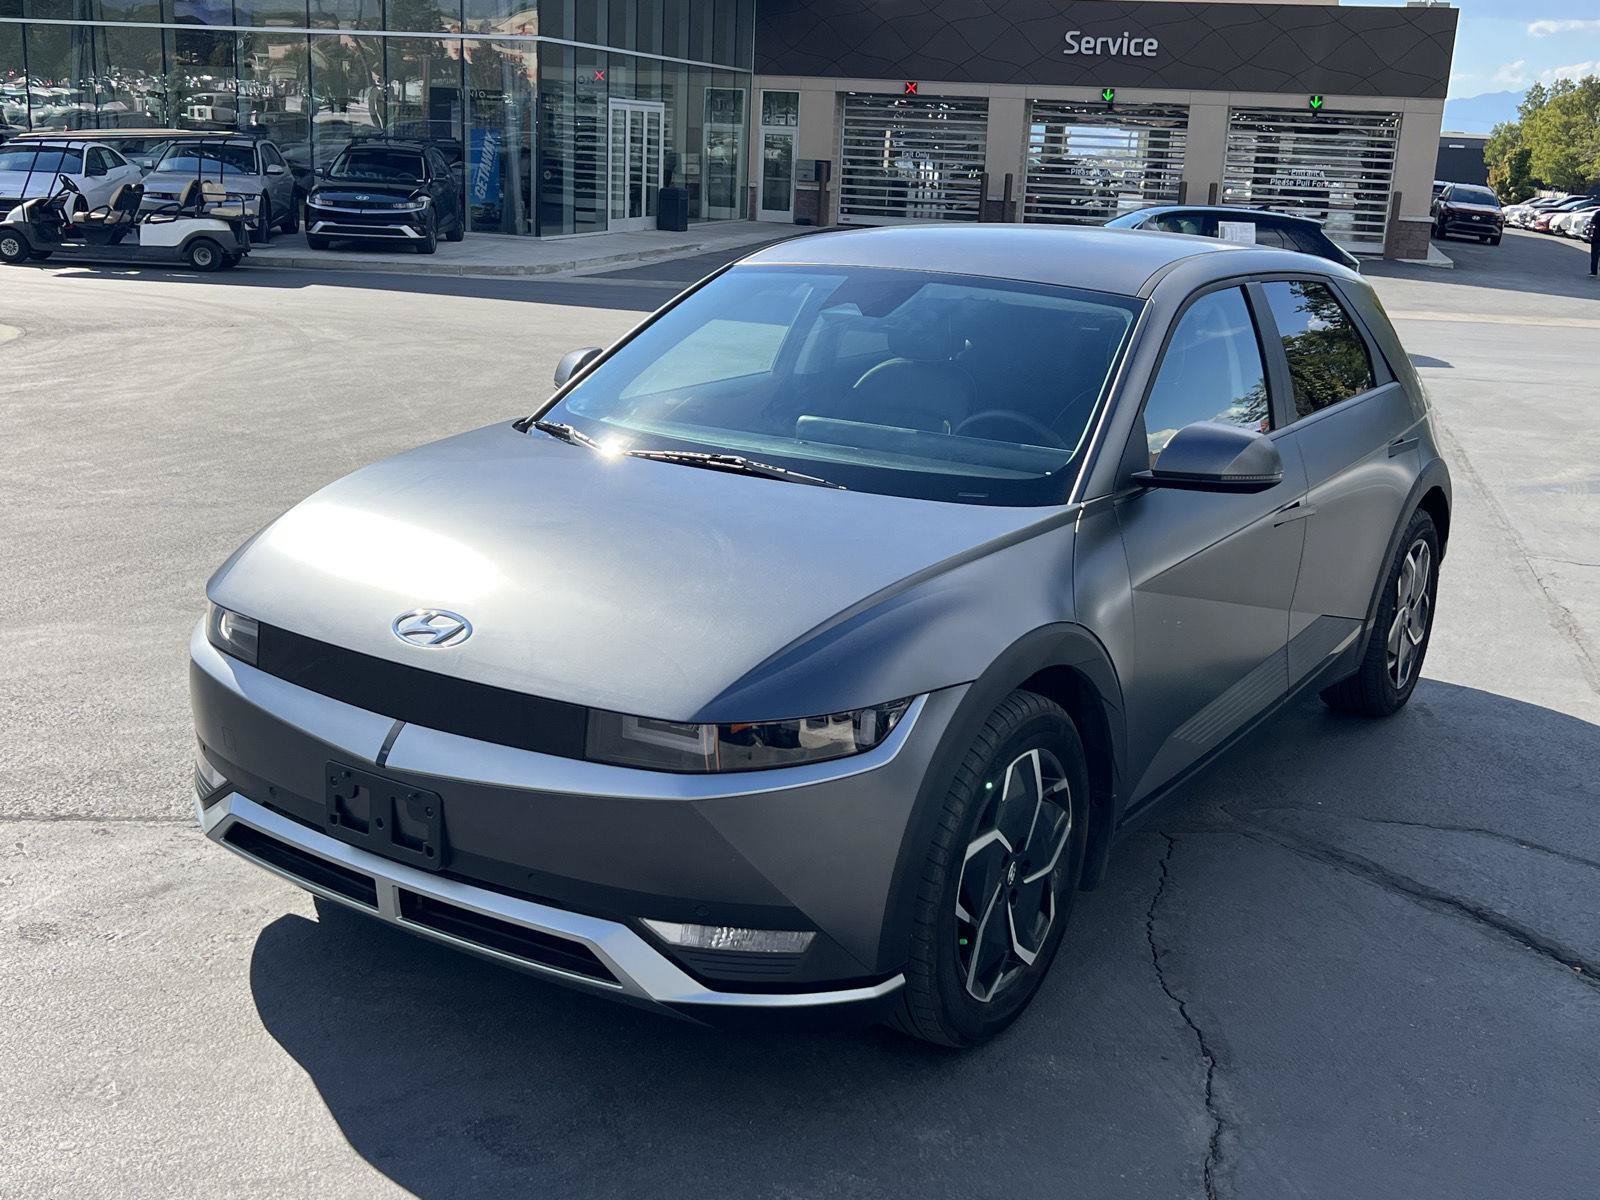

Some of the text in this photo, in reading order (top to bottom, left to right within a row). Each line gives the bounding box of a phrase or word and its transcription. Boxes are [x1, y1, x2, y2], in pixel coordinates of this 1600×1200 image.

[1064, 30, 1158, 57] Service
[475, 130, 496, 199] GETAWAY
[1270, 178, 1345, 188] Please Pull Forw
